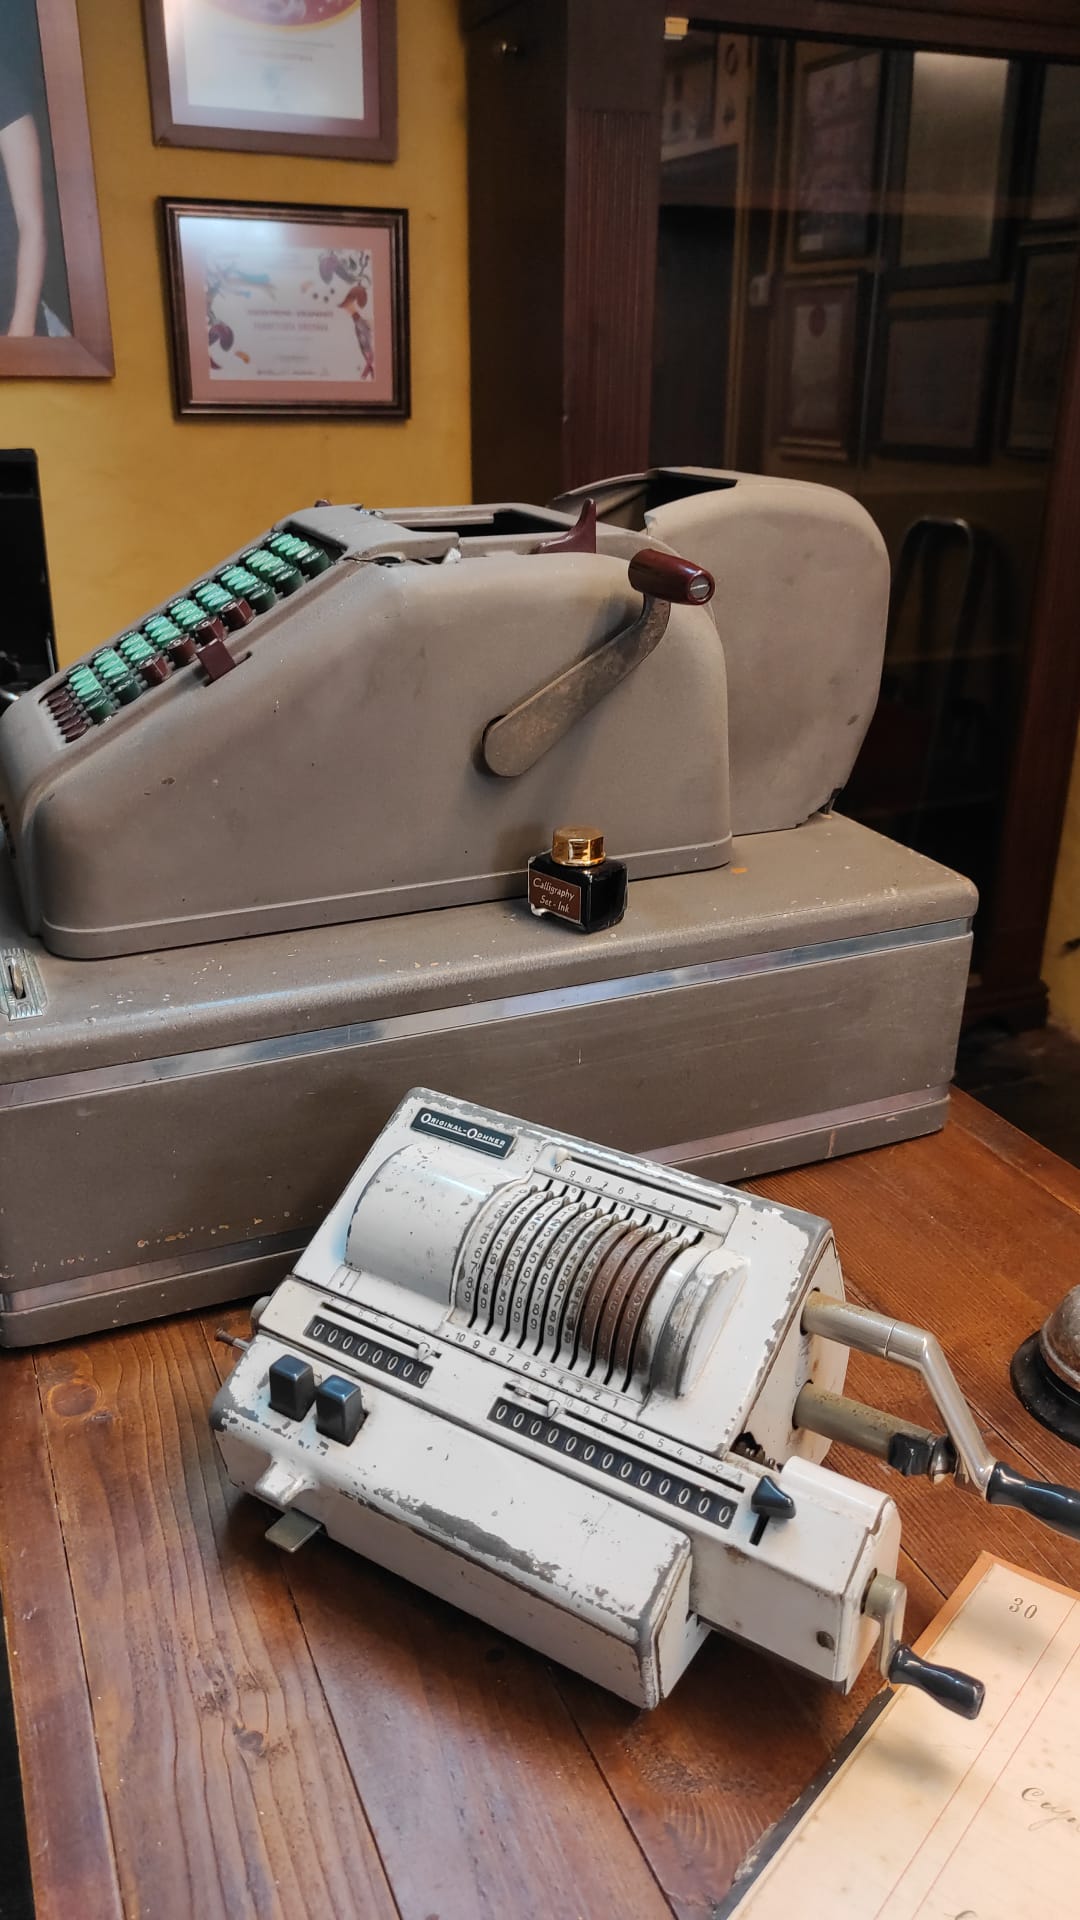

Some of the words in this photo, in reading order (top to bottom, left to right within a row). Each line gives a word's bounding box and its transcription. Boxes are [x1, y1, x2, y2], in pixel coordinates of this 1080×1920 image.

[533, 878, 575, 901] Calligraphy
[540, 895, 552, 906] Set
[558, 901, 570, 913] Ink
[1008, 1597, 1039, 1620] 30
